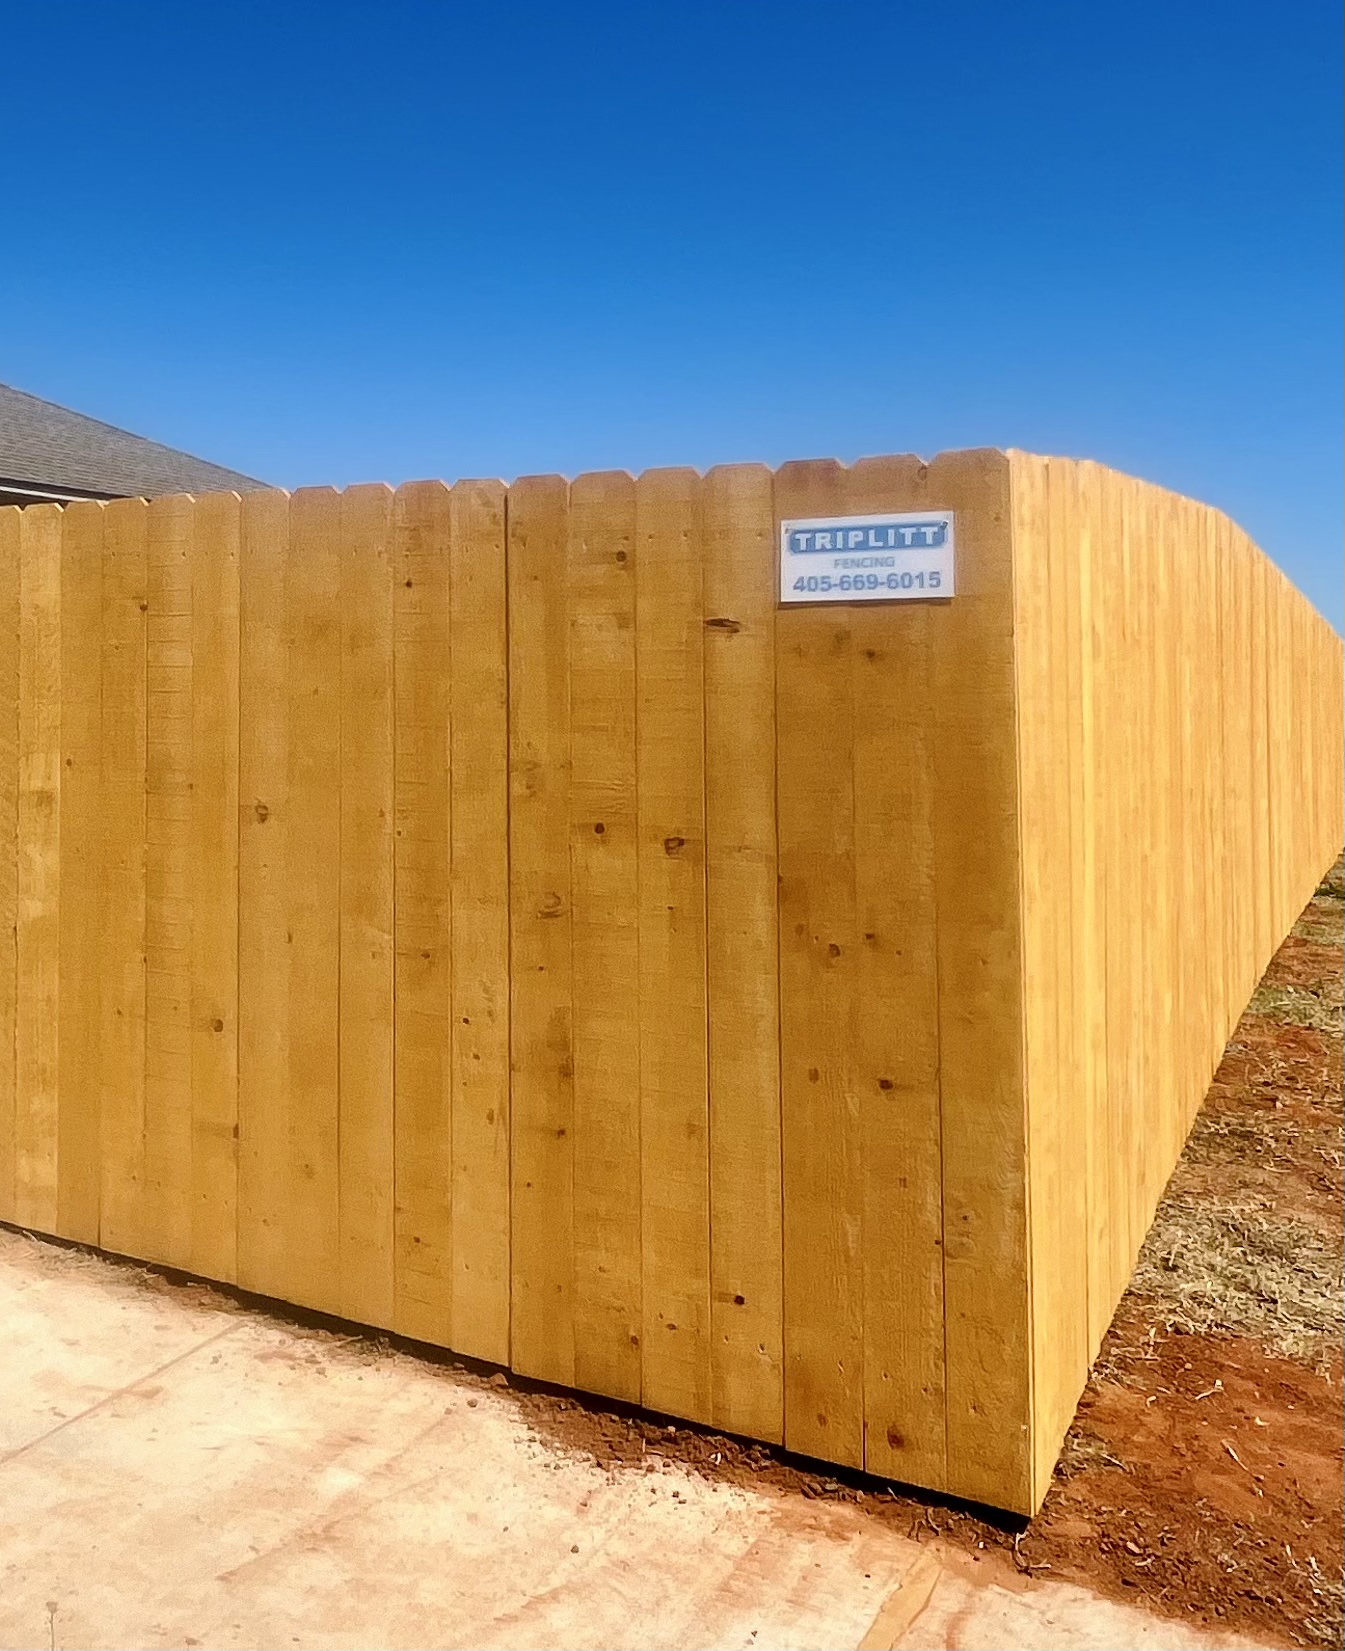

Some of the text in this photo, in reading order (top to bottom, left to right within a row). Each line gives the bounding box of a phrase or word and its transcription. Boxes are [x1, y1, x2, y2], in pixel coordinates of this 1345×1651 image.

[795, 526, 938, 550] TRIPLITT
[833, 556, 895, 569] FENCING
[793, 571, 941, 592] 405-669-6015
